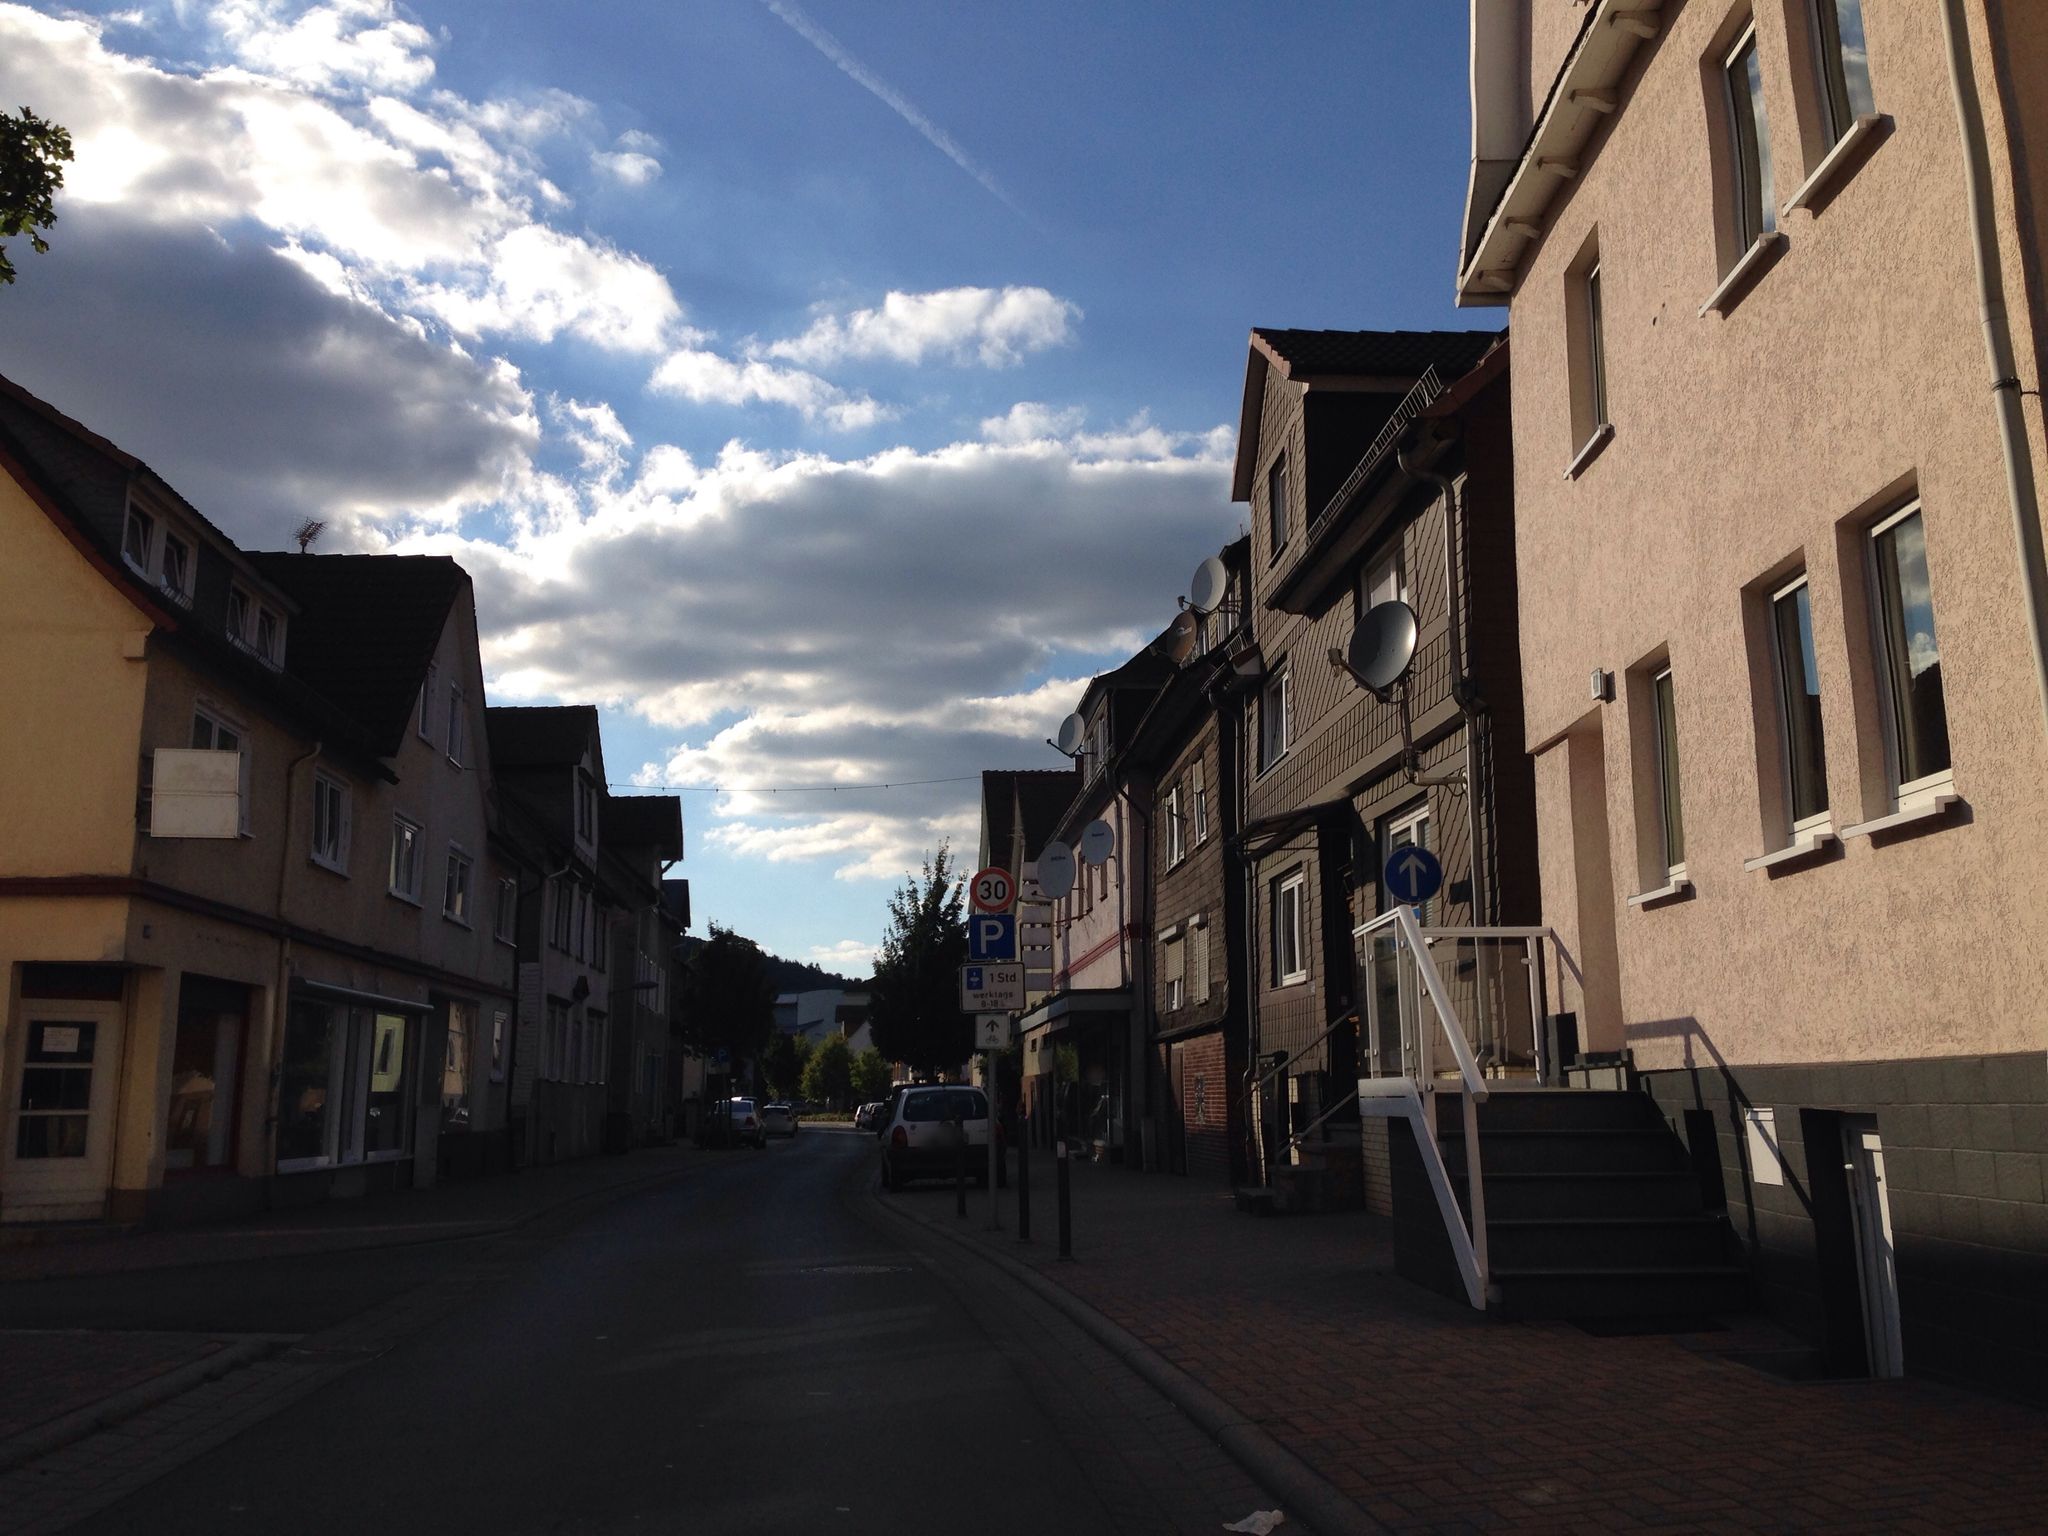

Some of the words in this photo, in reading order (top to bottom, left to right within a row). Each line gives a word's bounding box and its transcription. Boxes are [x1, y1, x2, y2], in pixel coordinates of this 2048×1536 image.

[980, 880, 1006, 900] 30
[980, 920, 1005, 954] P
[990, 973, 995, 983] 1
[998, 972, 1016, 983] Std
